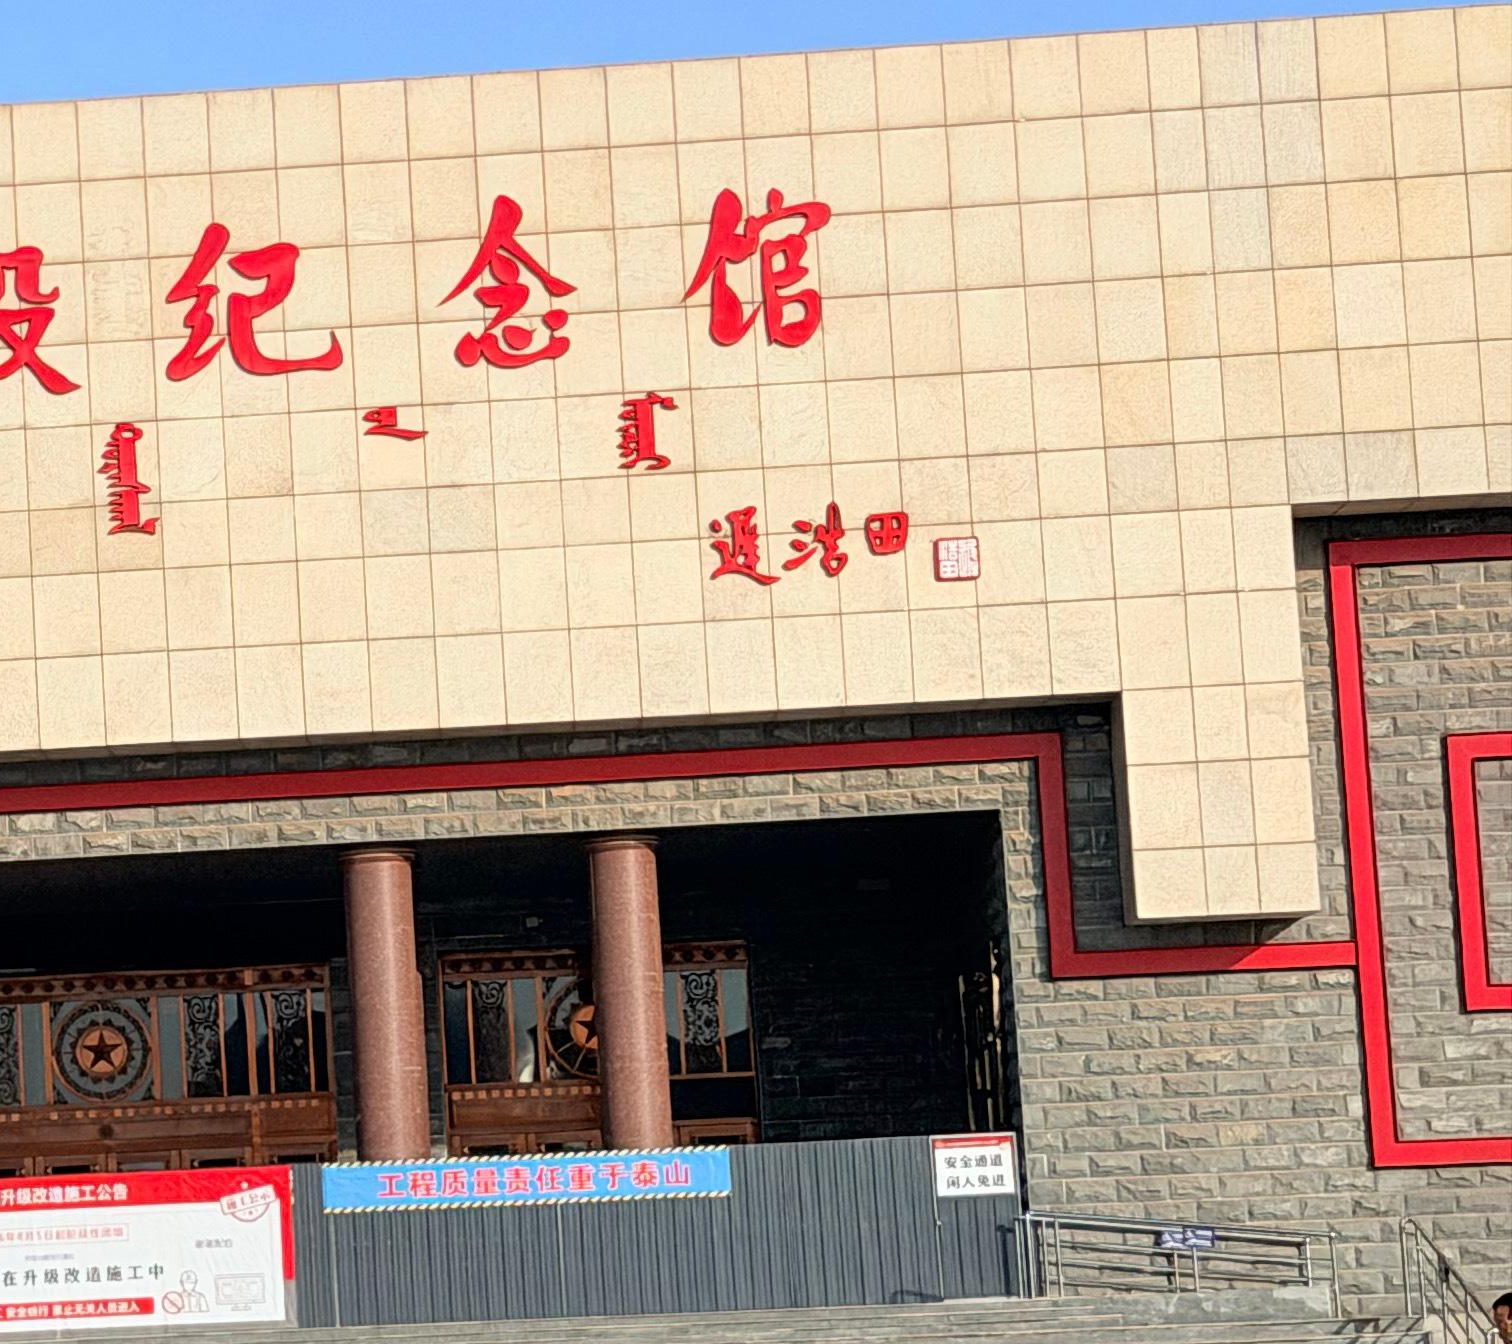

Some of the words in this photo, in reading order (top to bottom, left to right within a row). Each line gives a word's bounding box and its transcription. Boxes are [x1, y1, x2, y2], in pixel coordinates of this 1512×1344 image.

[944, 1153, 1003, 1169] 安全通道
[376, 1159, 692, 1199] 工程质量责任重于泰山
[946, 1174, 1006, 1189] 闲人免进
